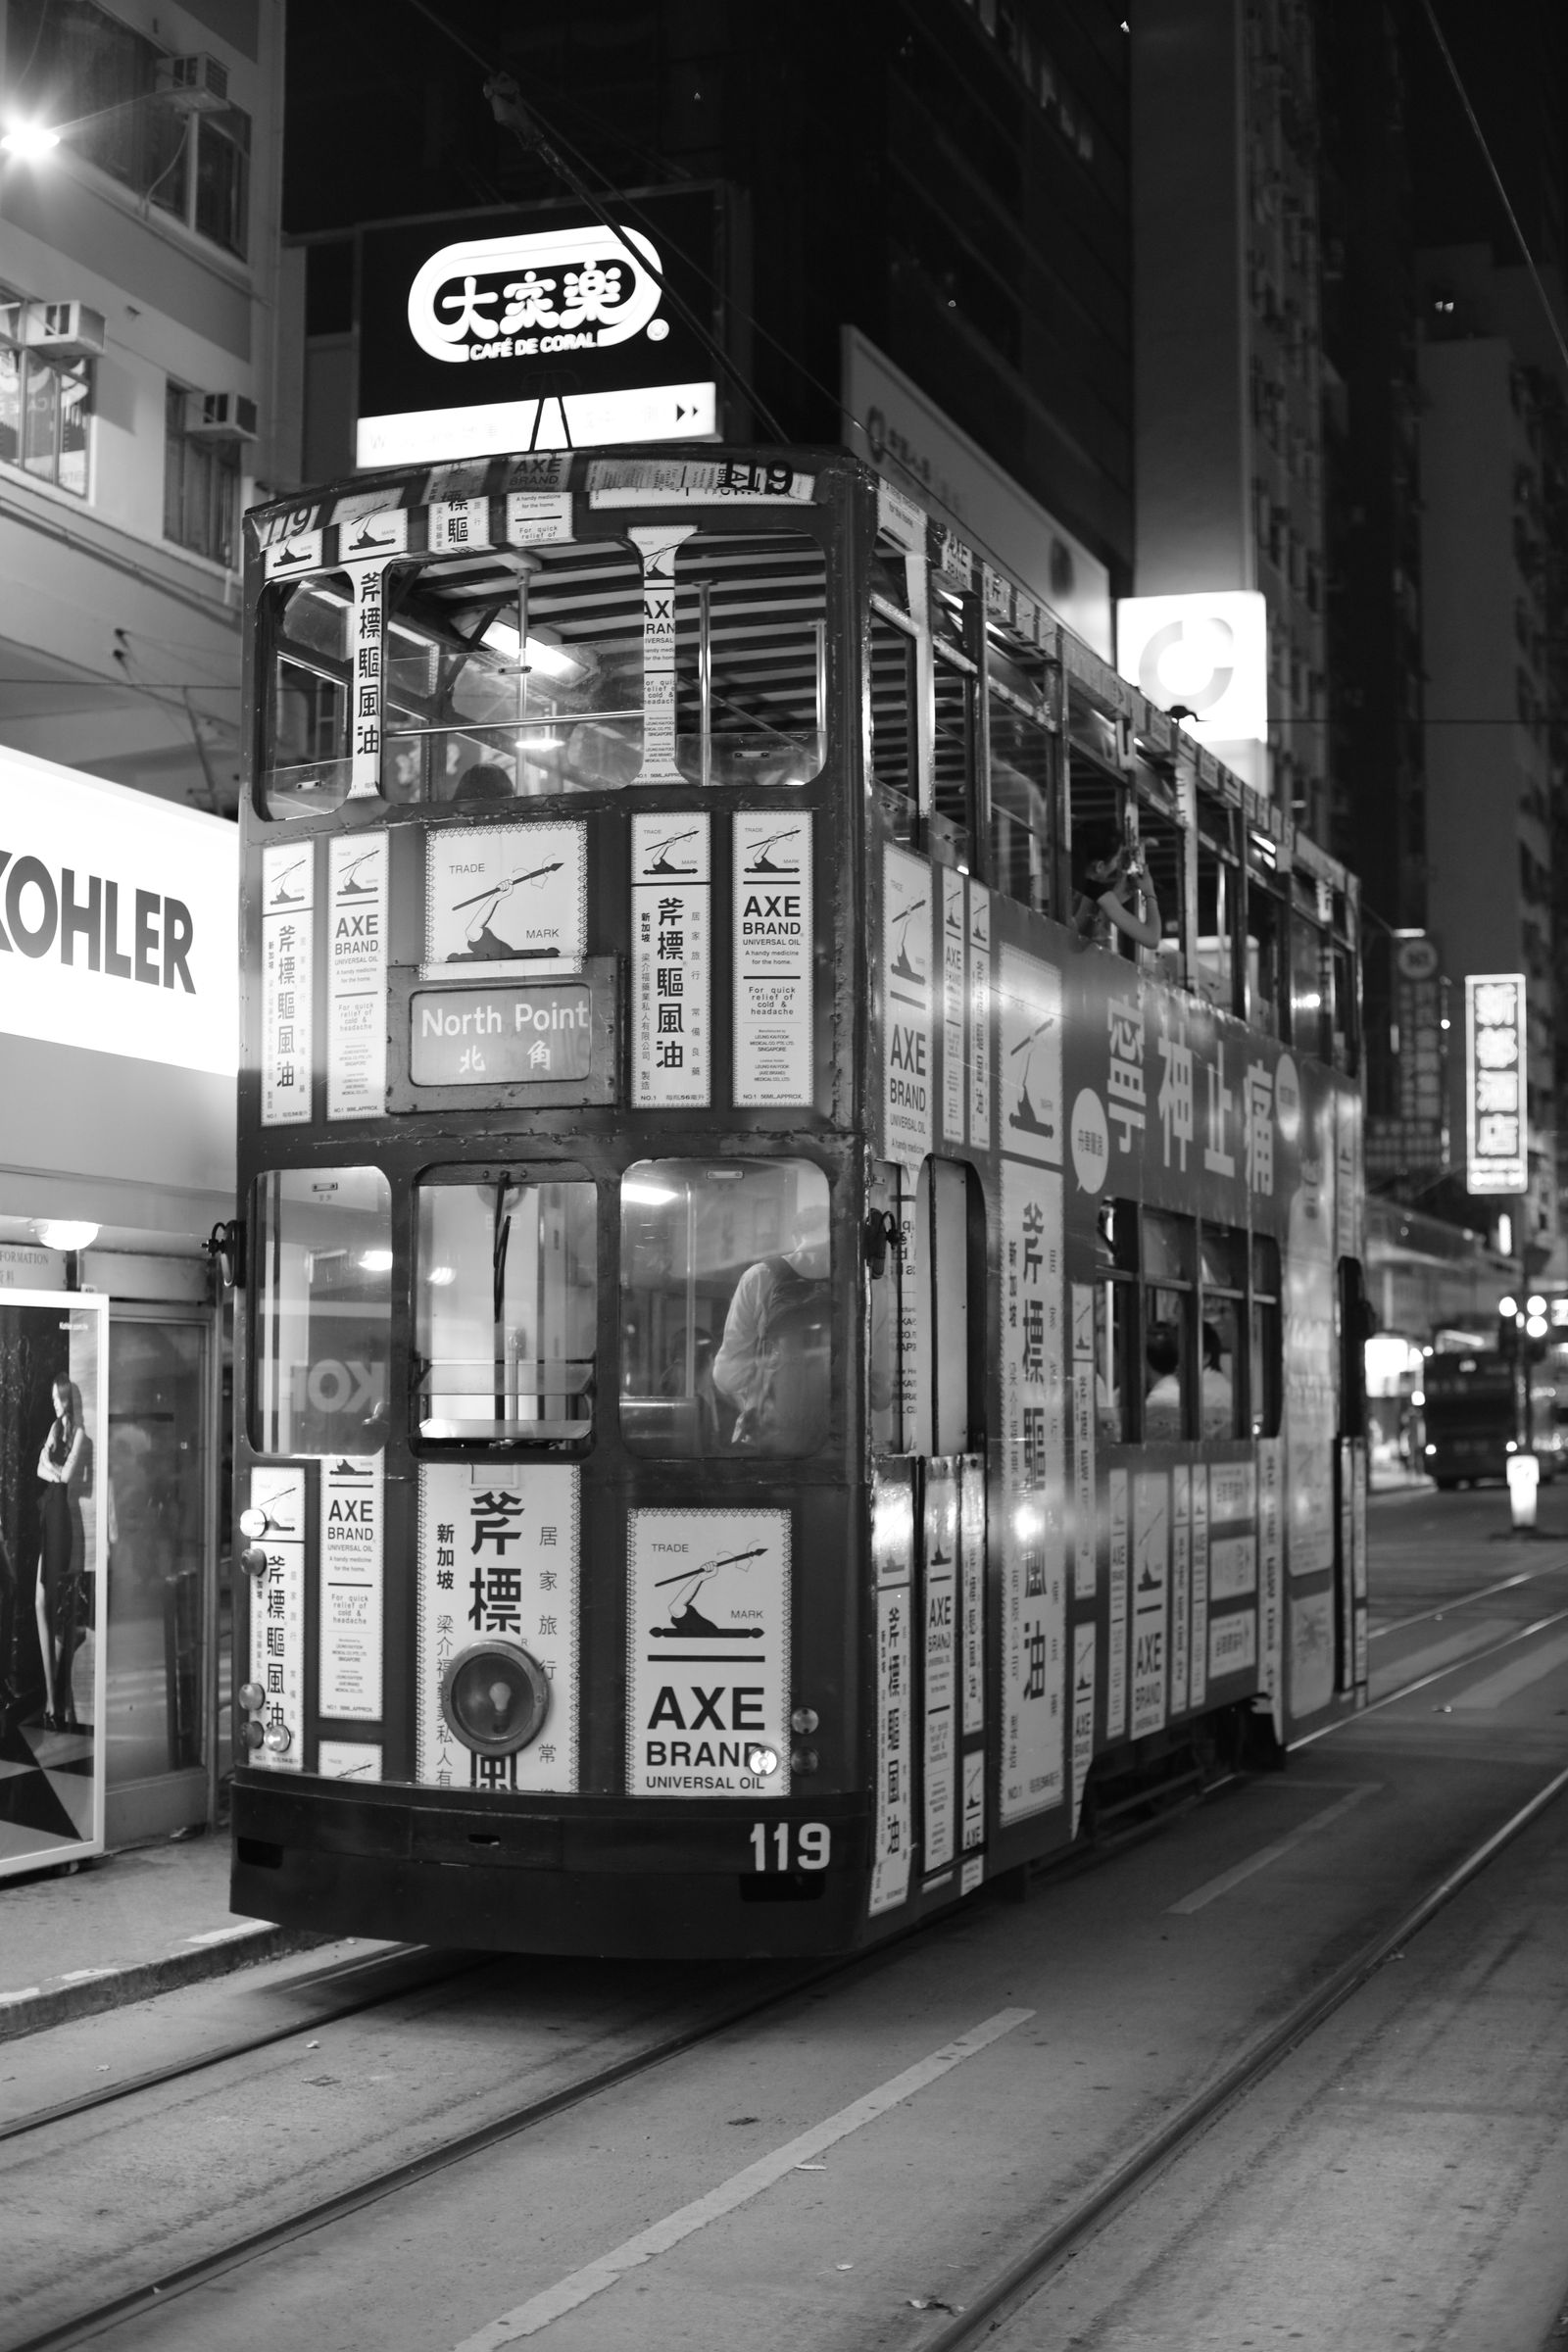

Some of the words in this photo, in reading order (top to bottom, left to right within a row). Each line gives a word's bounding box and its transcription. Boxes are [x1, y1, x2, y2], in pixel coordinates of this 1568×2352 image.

[469, 338, 514, 361] CAFÉ
[514, 338, 538, 357] DE
[539, 331, 598, 353] CORAL
[514, 459, 563, 474] AXE
[510, 475, 559, 486] BRAND
[537, 525, 558, 534] quick
[357, 571, 380, 756] 斧標驅風油
[449, 863, 485, 874] TRADE
[743, 896, 801, 917] AXE
[336, 914, 378, 938] AXE
[526, 928, 560, 939] MARK
[641, 912, 651, 943] 新加坡
[743, 922, 801, 935] BRAND
[335, 940, 378, 956] BRAND
[335, 956, 368, 965] UNIVERSAL
[657, 898, 684, 1068] 斧標驅風油
[277, 924, 295, 1087] 斧標驅風油
[421, 1005, 502, 1037] North
[515, 1001, 588, 1032] Point
[459, 1040, 551, 1073] 北角
[891, 1024, 926, 1076] AXE
[890, 1078, 926, 1112] BRAND
[890, 1113, 917, 1132] UNIVERSAL
[328, 1499, 373, 1522] AXE
[327, 1527, 373, 1541] BRAND
[437, 1524, 455, 1590] 新加坡
[539, 1526, 558, 1681] 居家旅行
[731, 1610, 764, 1619] MARK
[930, 1596, 952, 1627] AXE
[1136, 1633, 1161, 1678] AXE
[648, 1687, 765, 1731] AXE
[647, 1777, 735, 1789] UNIVERSAL
[740, 1777, 765, 1789] OIL
[750, 1823, 831, 1872] 119
